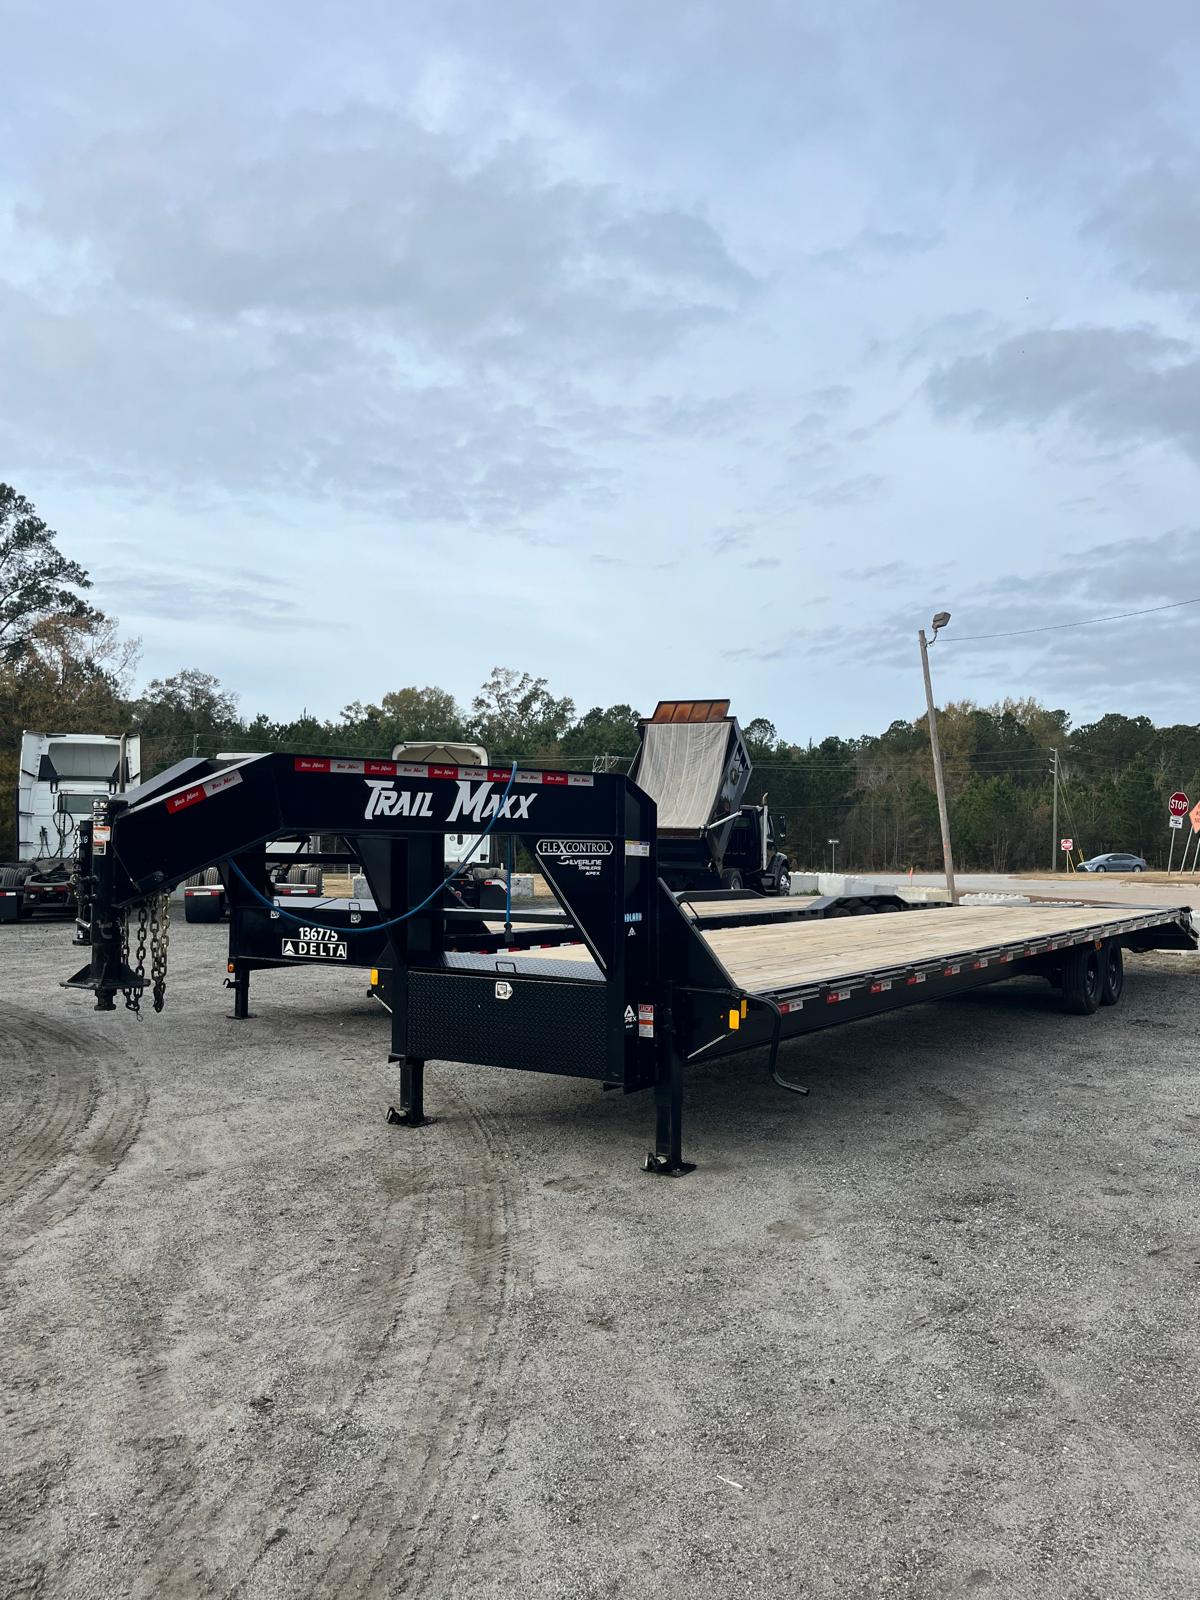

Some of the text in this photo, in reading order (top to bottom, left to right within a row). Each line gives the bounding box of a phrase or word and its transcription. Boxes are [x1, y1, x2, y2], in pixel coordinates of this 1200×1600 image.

[364, 779, 538, 822] TRAIL MAXX
[1170, 799, 1188, 810] STOP
[542, 841, 609, 854] FLEXCONTROL
[299, 927, 338, 941] 136775
[299, 942, 345, 957] DELTA
